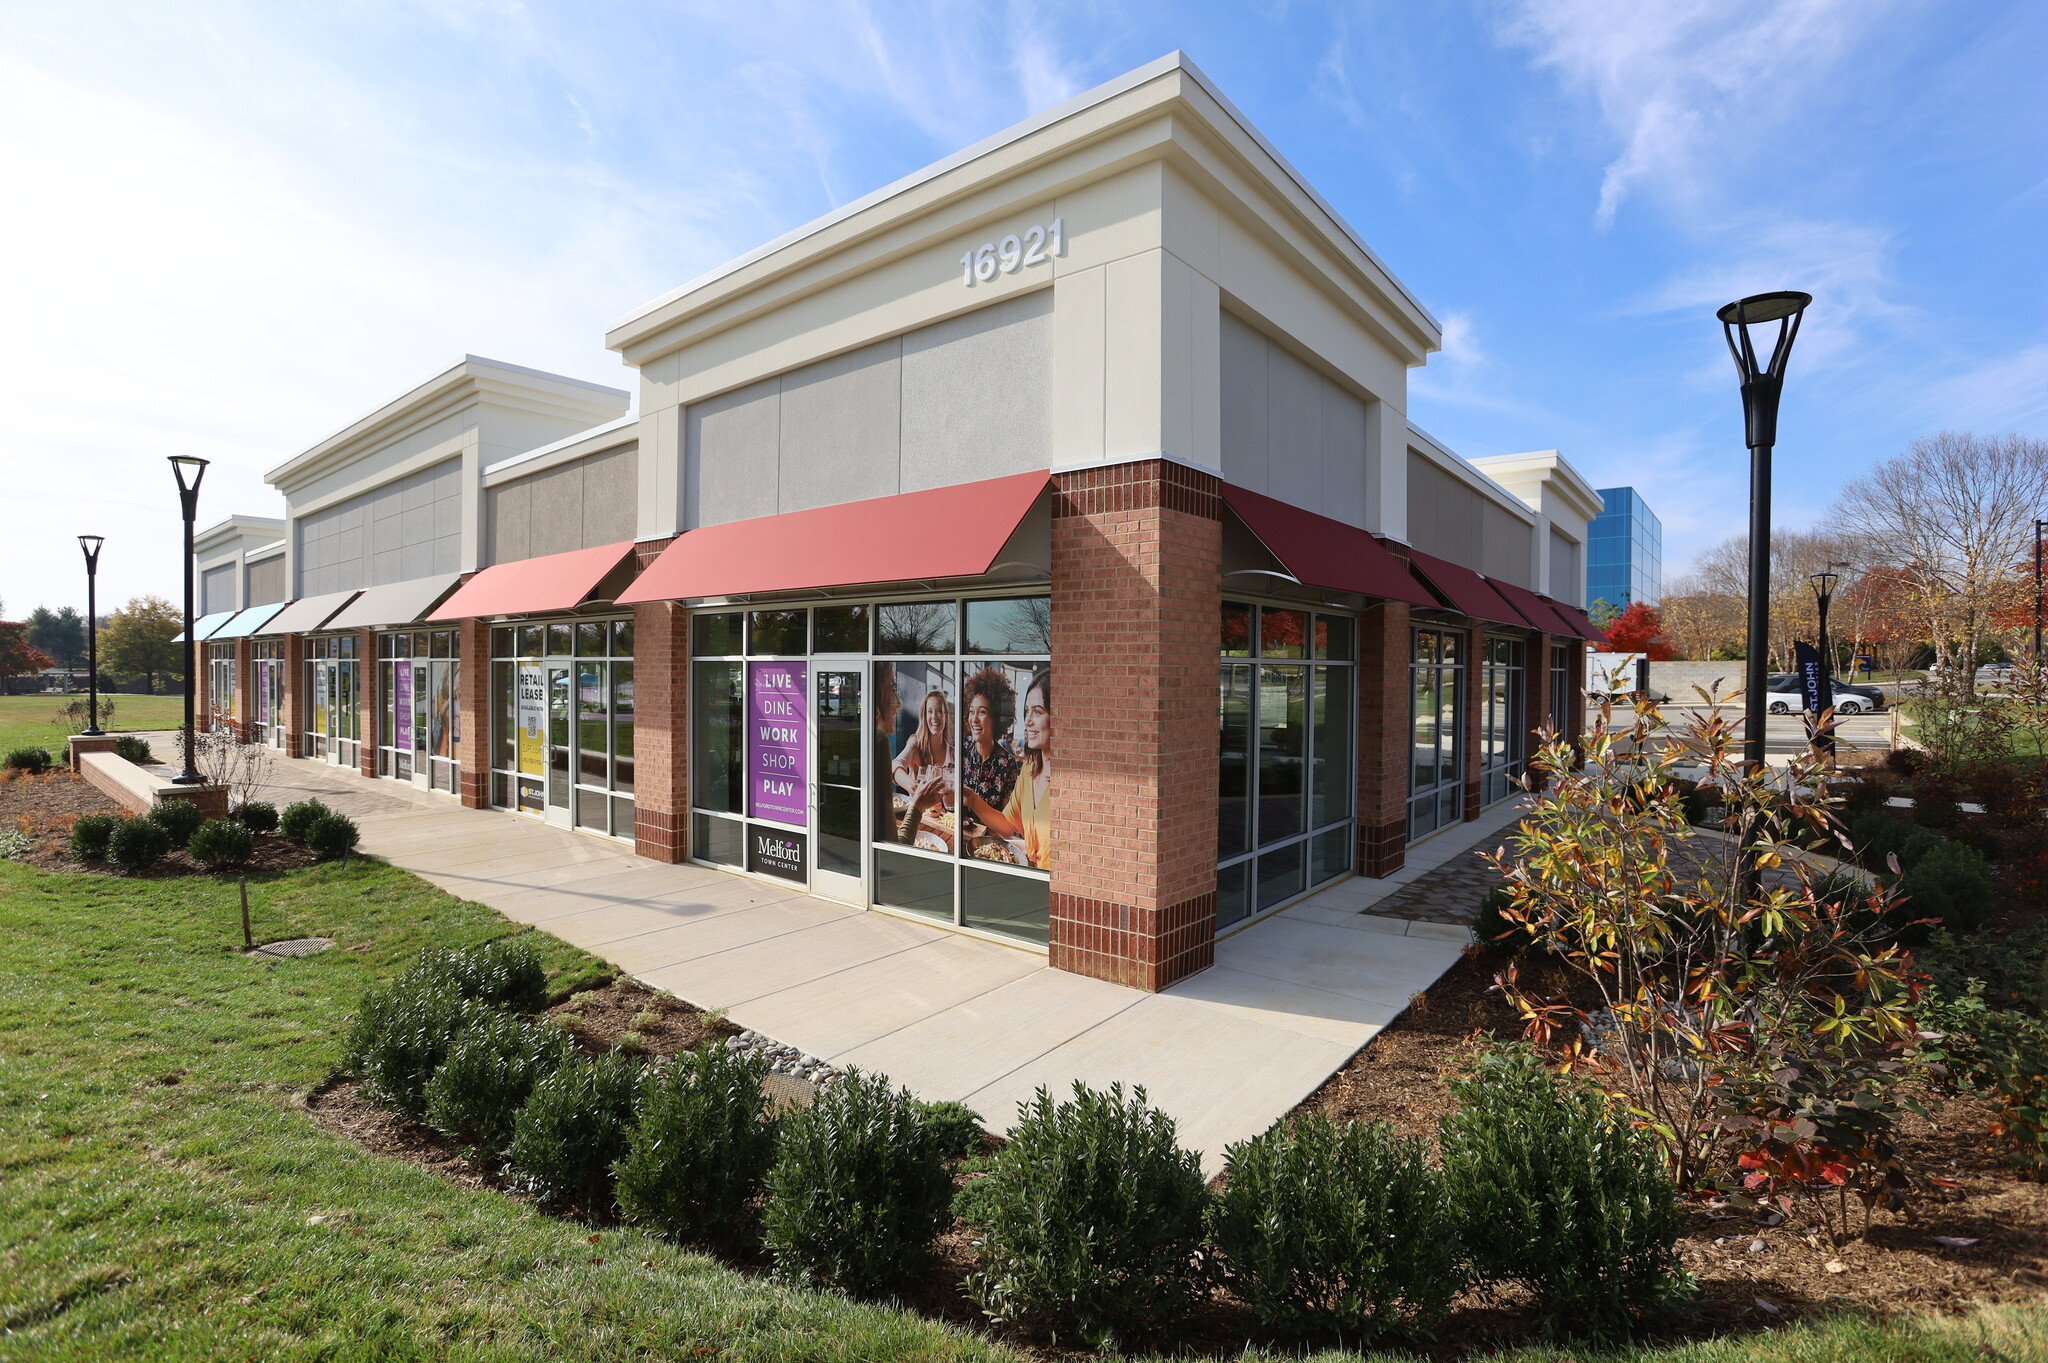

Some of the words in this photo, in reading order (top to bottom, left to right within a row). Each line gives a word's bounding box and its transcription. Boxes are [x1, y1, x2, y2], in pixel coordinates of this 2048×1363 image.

[960, 217, 1063, 288] 16921
[520, 674, 544, 686] RETAIL
[765, 674, 792, 688] LIVE
[521, 688, 543, 700] LEASE
[764, 700, 793, 715] DINE
[760, 726, 798, 743] WORK
[762, 753, 795, 769] SHOP
[763, 779, 794, 797] PLAY
[758, 836, 801, 862] Melford
[761, 857, 776, 867] TOWN
[777, 861, 798, 872] CENTER
